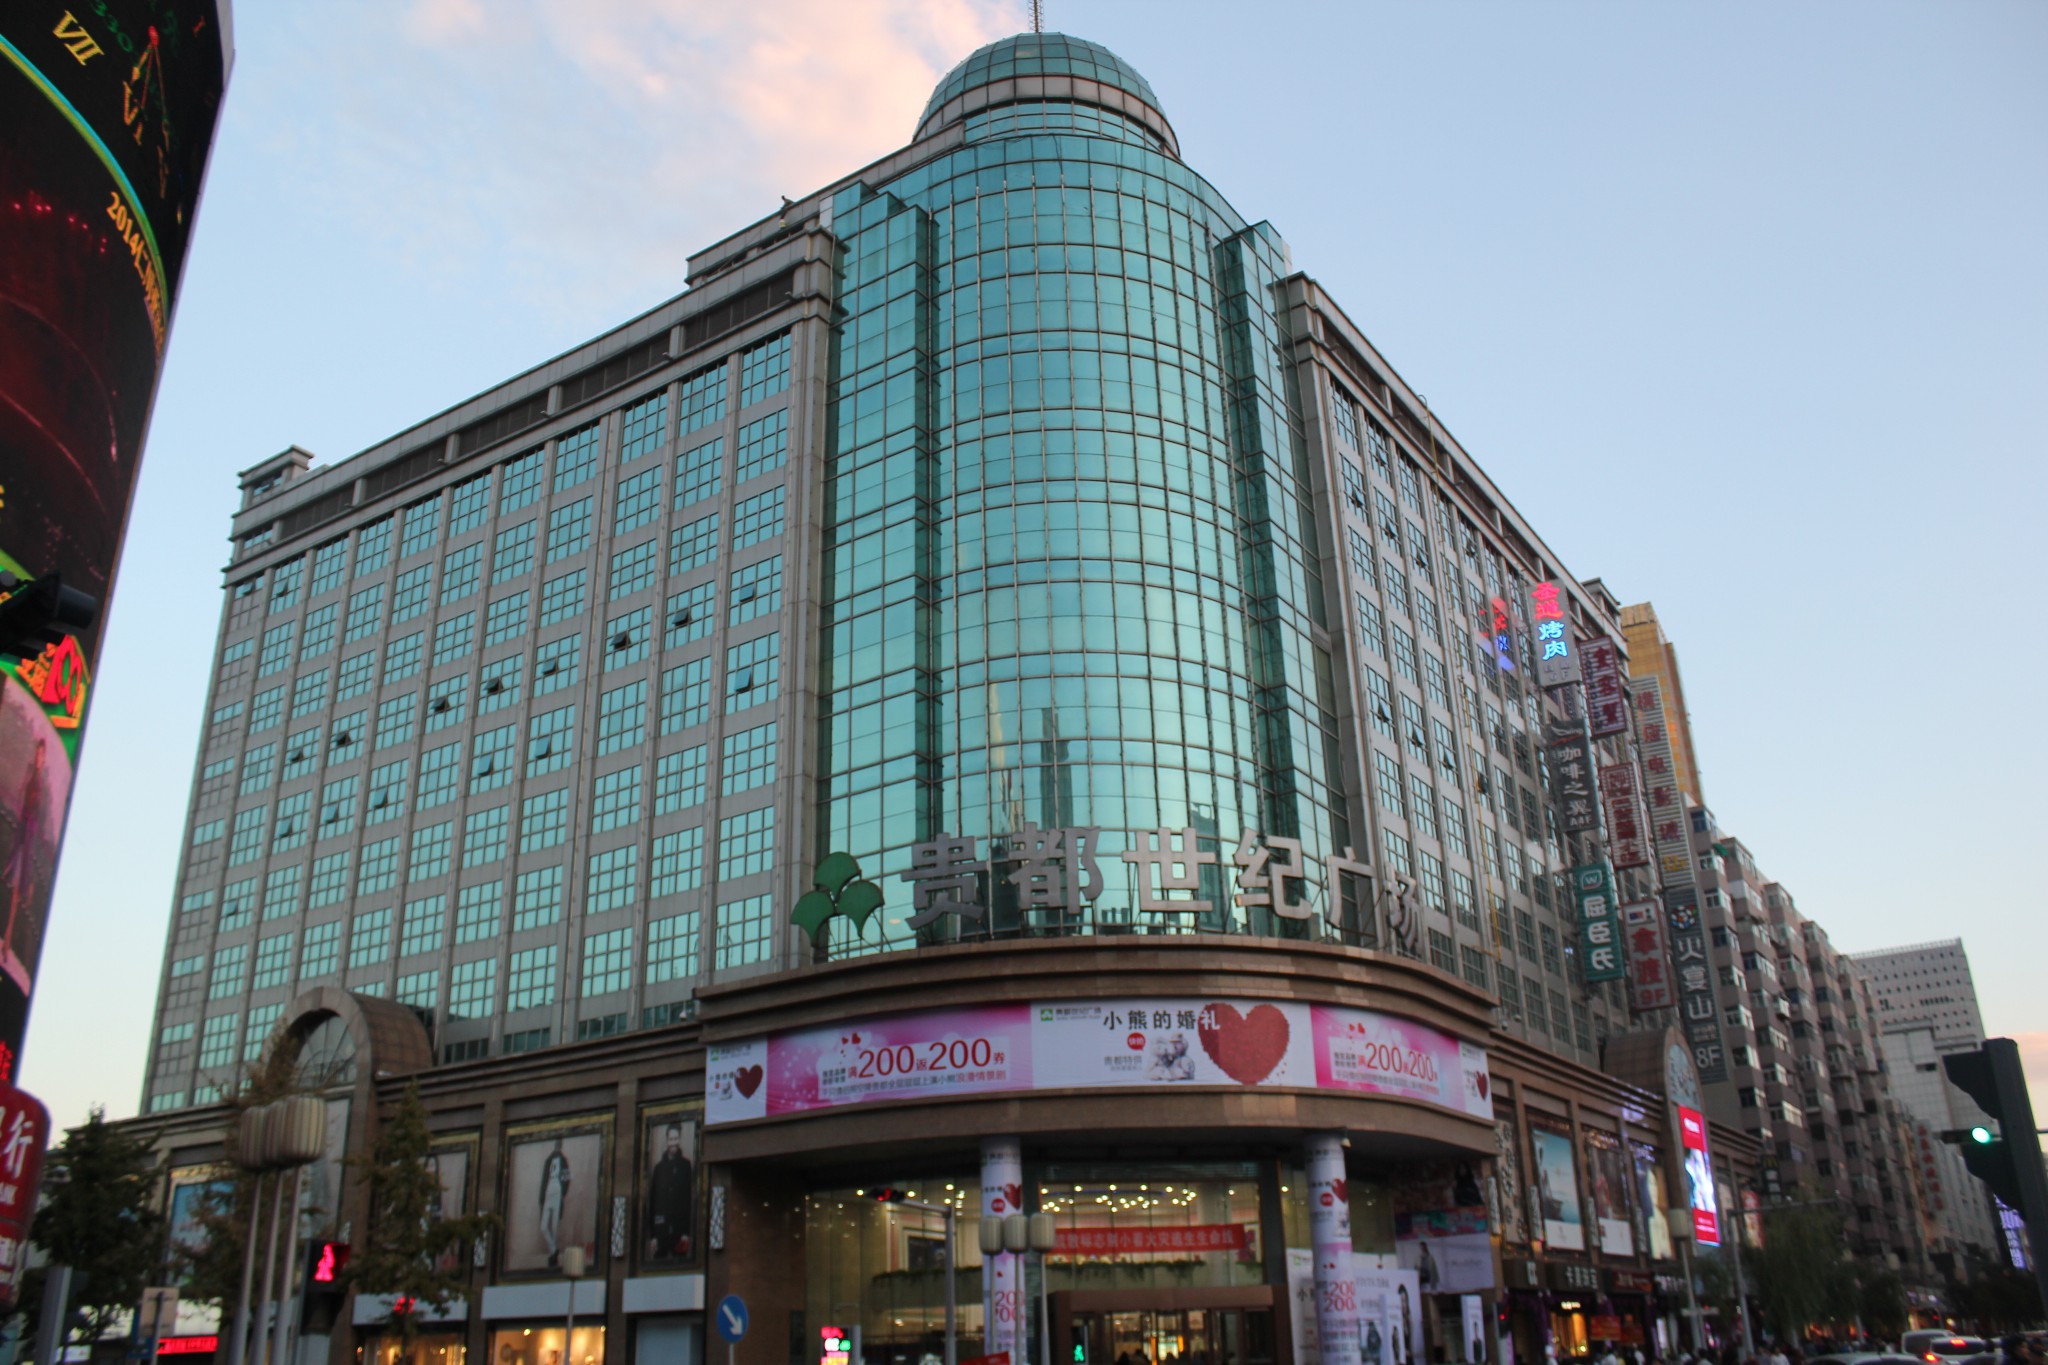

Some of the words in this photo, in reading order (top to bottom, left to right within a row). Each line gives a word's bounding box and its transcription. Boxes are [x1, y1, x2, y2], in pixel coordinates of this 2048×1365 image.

[52, 9, 105, 66] VII
[1558, 746, 1591, 816] 咖啡之翼
[900, 820, 1421, 956] 贵都世纪广场
[1584, 895, 1615, 970] 屈臣氏
[1678, 936, 1713, 1020] 火宴山
[1103, 1010, 1221, 1031] 小熊的婚礼
[1696, 1046, 1721, 1069] 8F
